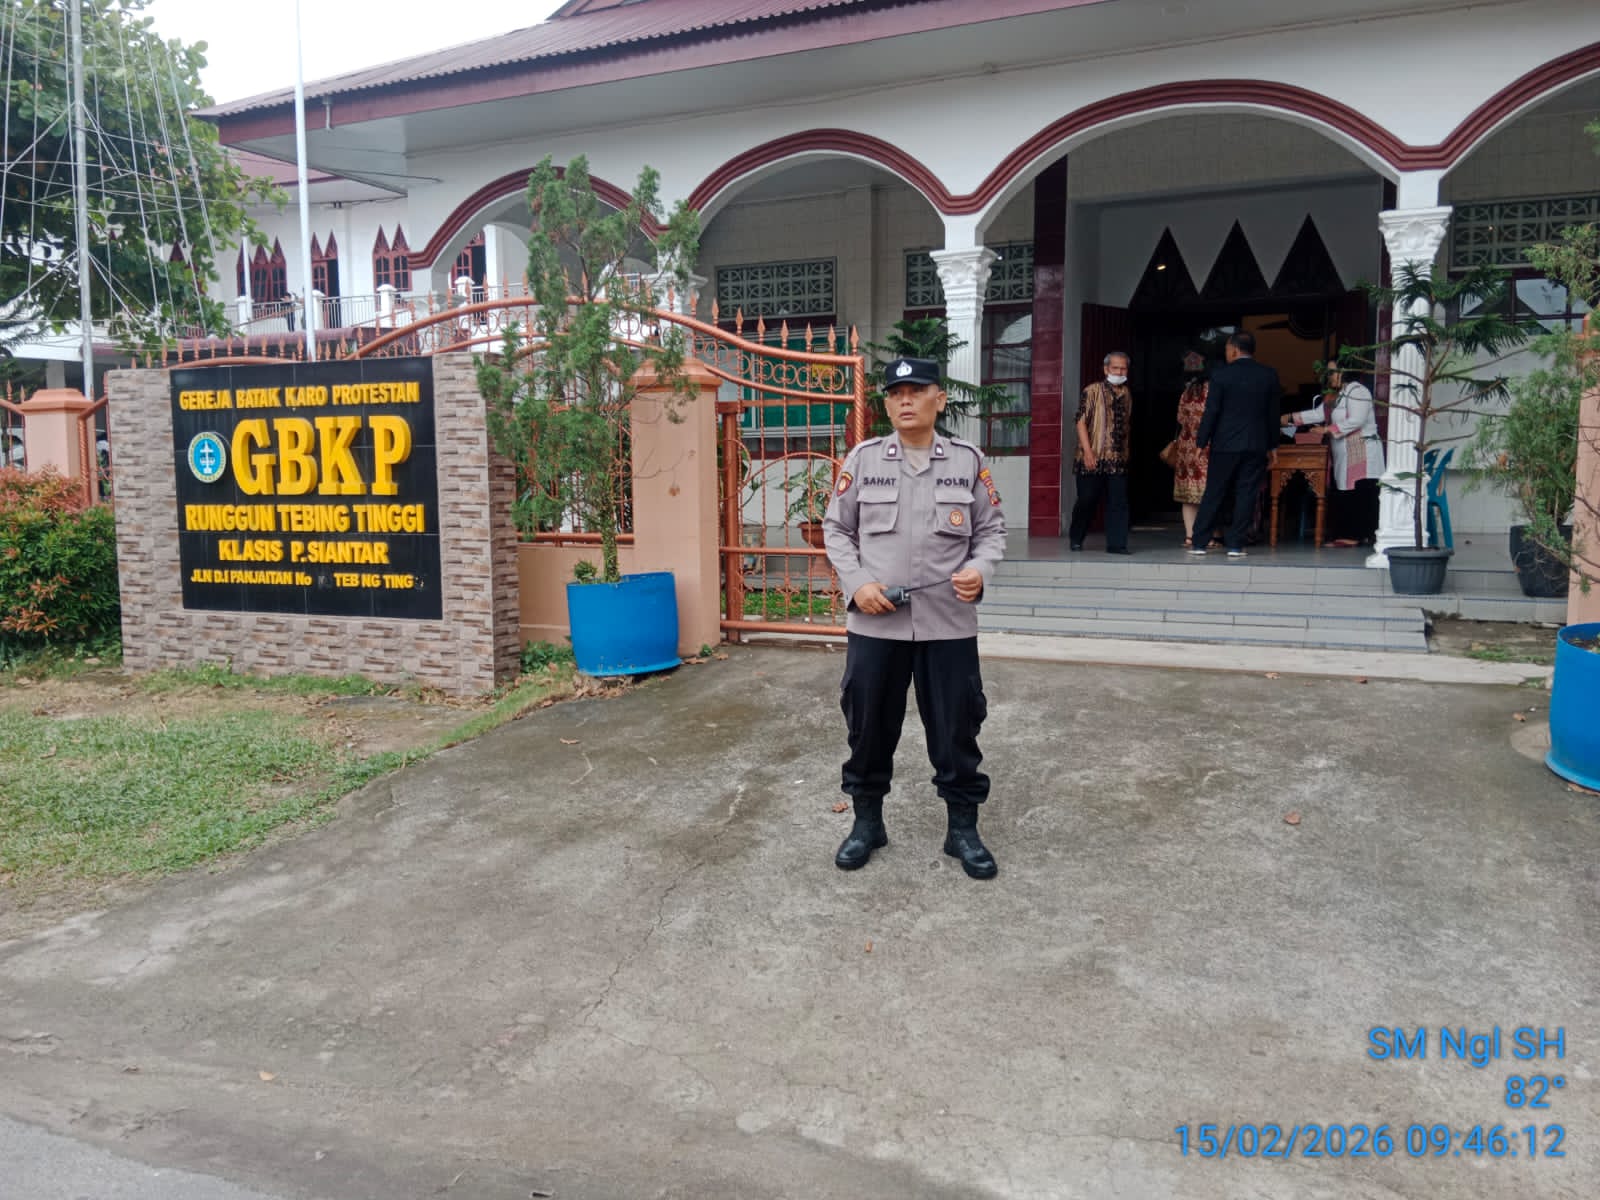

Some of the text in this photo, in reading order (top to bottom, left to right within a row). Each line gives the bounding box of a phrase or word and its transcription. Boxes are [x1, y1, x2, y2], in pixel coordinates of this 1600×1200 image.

[179, 382, 419, 410] GEREJA BATAK KARO PROTESTAN
[231, 415, 411, 495] GBKP
[863, 477, 896, 486] SAHAT
[936, 478, 969, 487] POLRI
[185, 504, 424, 532] RUNGGUN TEBING TINGGI
[218, 539, 389, 564] KLASIS P.SIANTAR
[191, 569, 212, 583] JLN
[230, 570, 293, 584] PANJAITAN
[295, 572, 312, 585] No
[382, 574, 422, 588] TING
